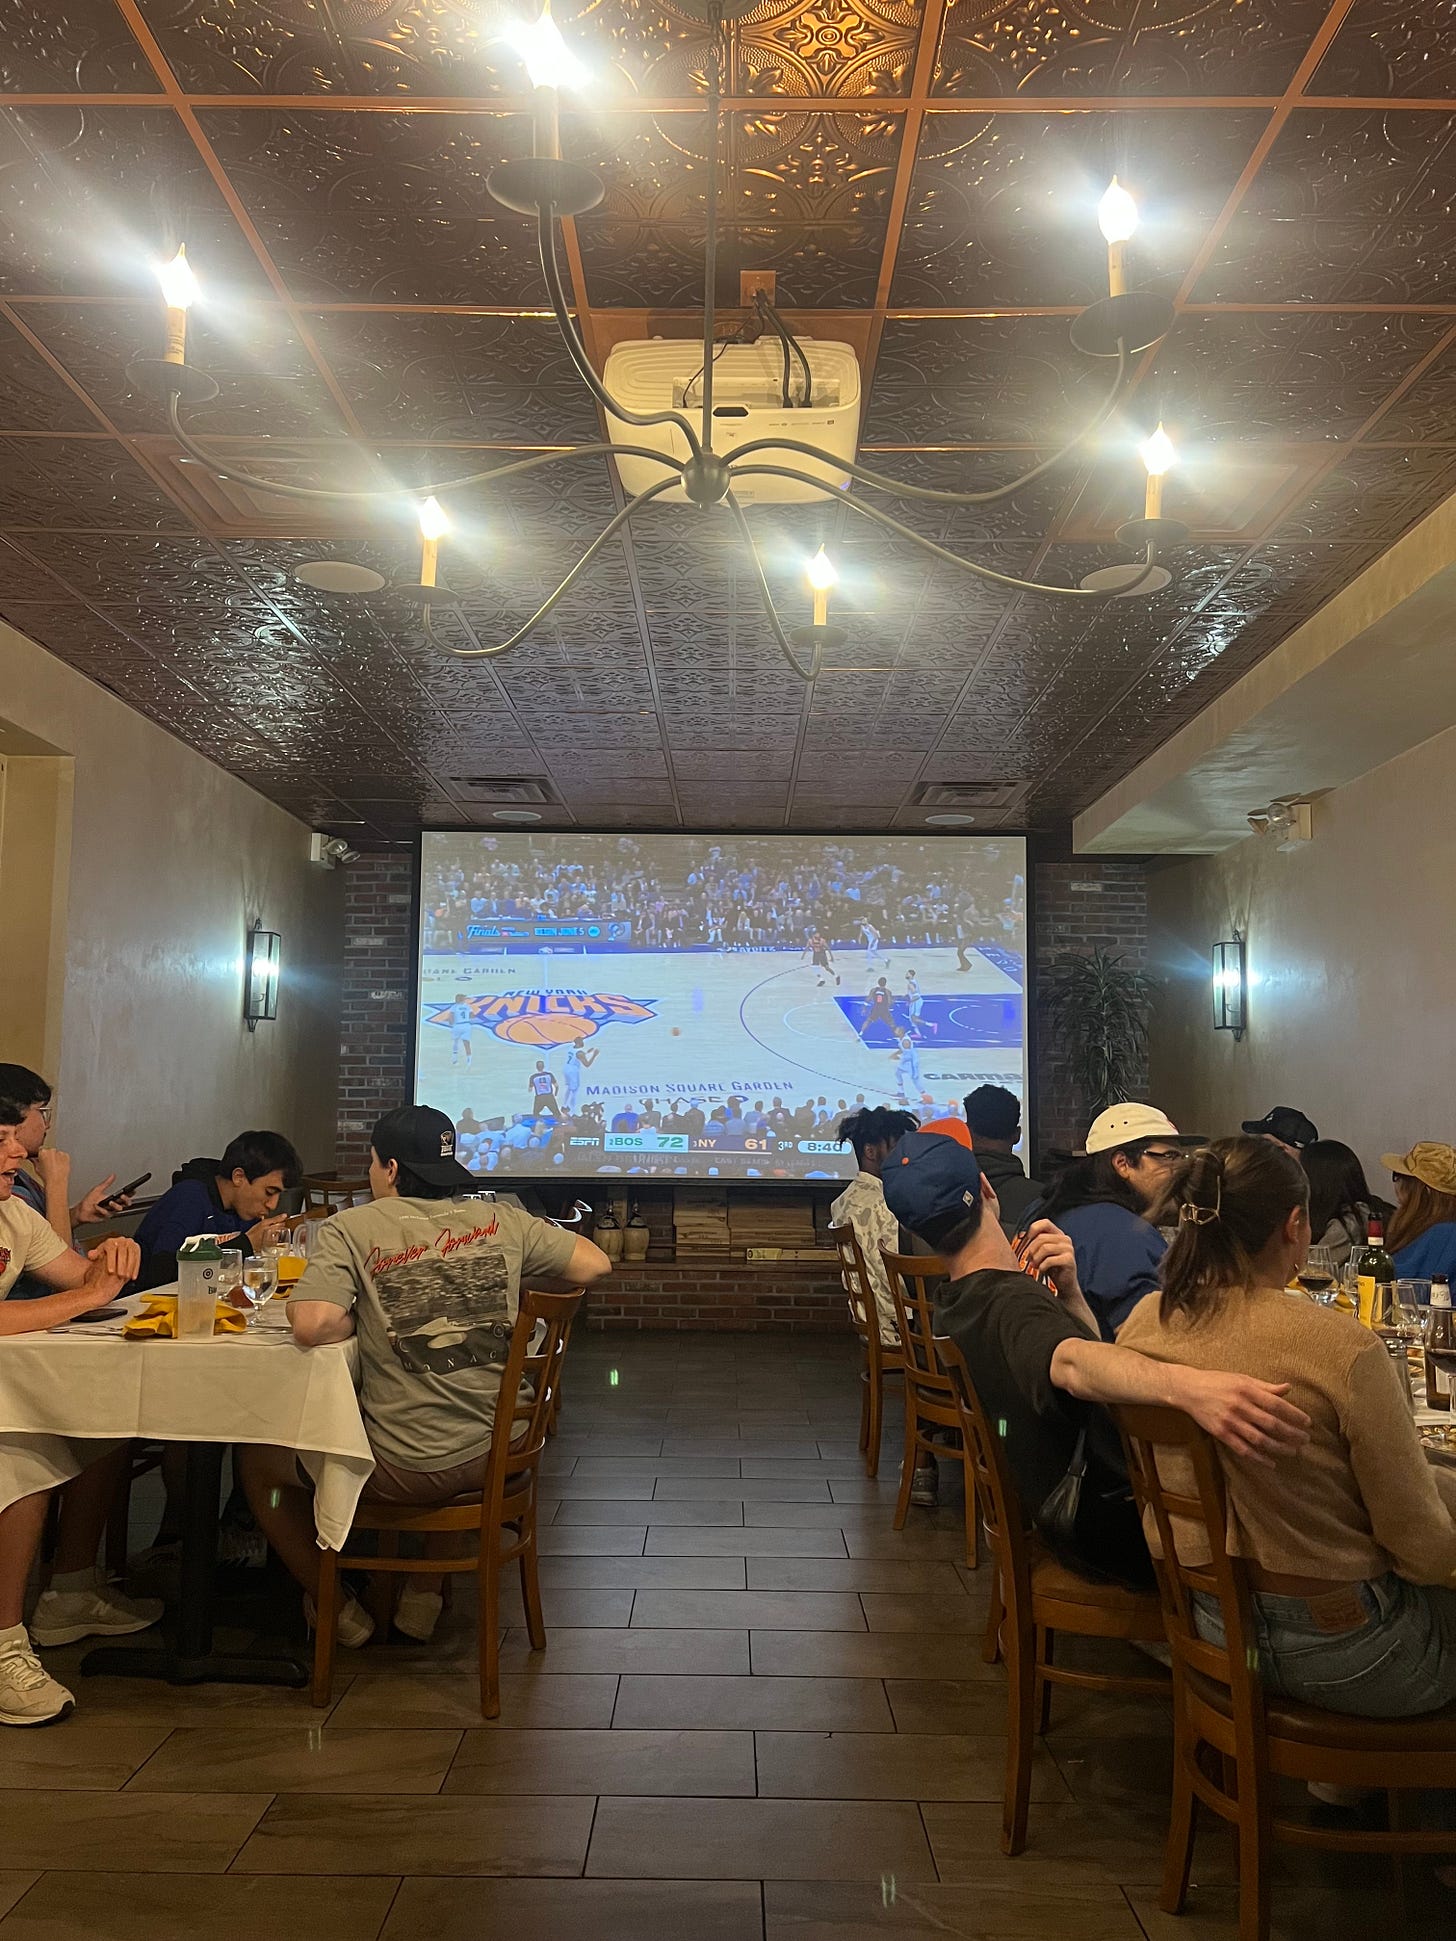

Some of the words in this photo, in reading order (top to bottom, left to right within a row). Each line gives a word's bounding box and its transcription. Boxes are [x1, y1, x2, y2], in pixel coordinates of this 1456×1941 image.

[426, 994, 658, 1024] KNICKS
[586, 1085, 660, 1096] MADISON
[666, 1082, 726, 1093] SQUARE
[731, 1081, 794, 1091] GARDEN
[569, 1136, 600, 1147] ESPN
[614, 1137, 643, 1146] BOS
[656, 1136, 684, 1148] 72
[698, 1139, 717, 1148] NY
[744, 1138, 767, 1150] 61
[777, 1141, 793, 1151] 3RD
[807, 1142, 843, 1152] 8:40
[363, 1244, 429, 1281] Forever
[434, 1212, 500, 1258] Forward
[404, 1350, 497, 1371] MONAC
